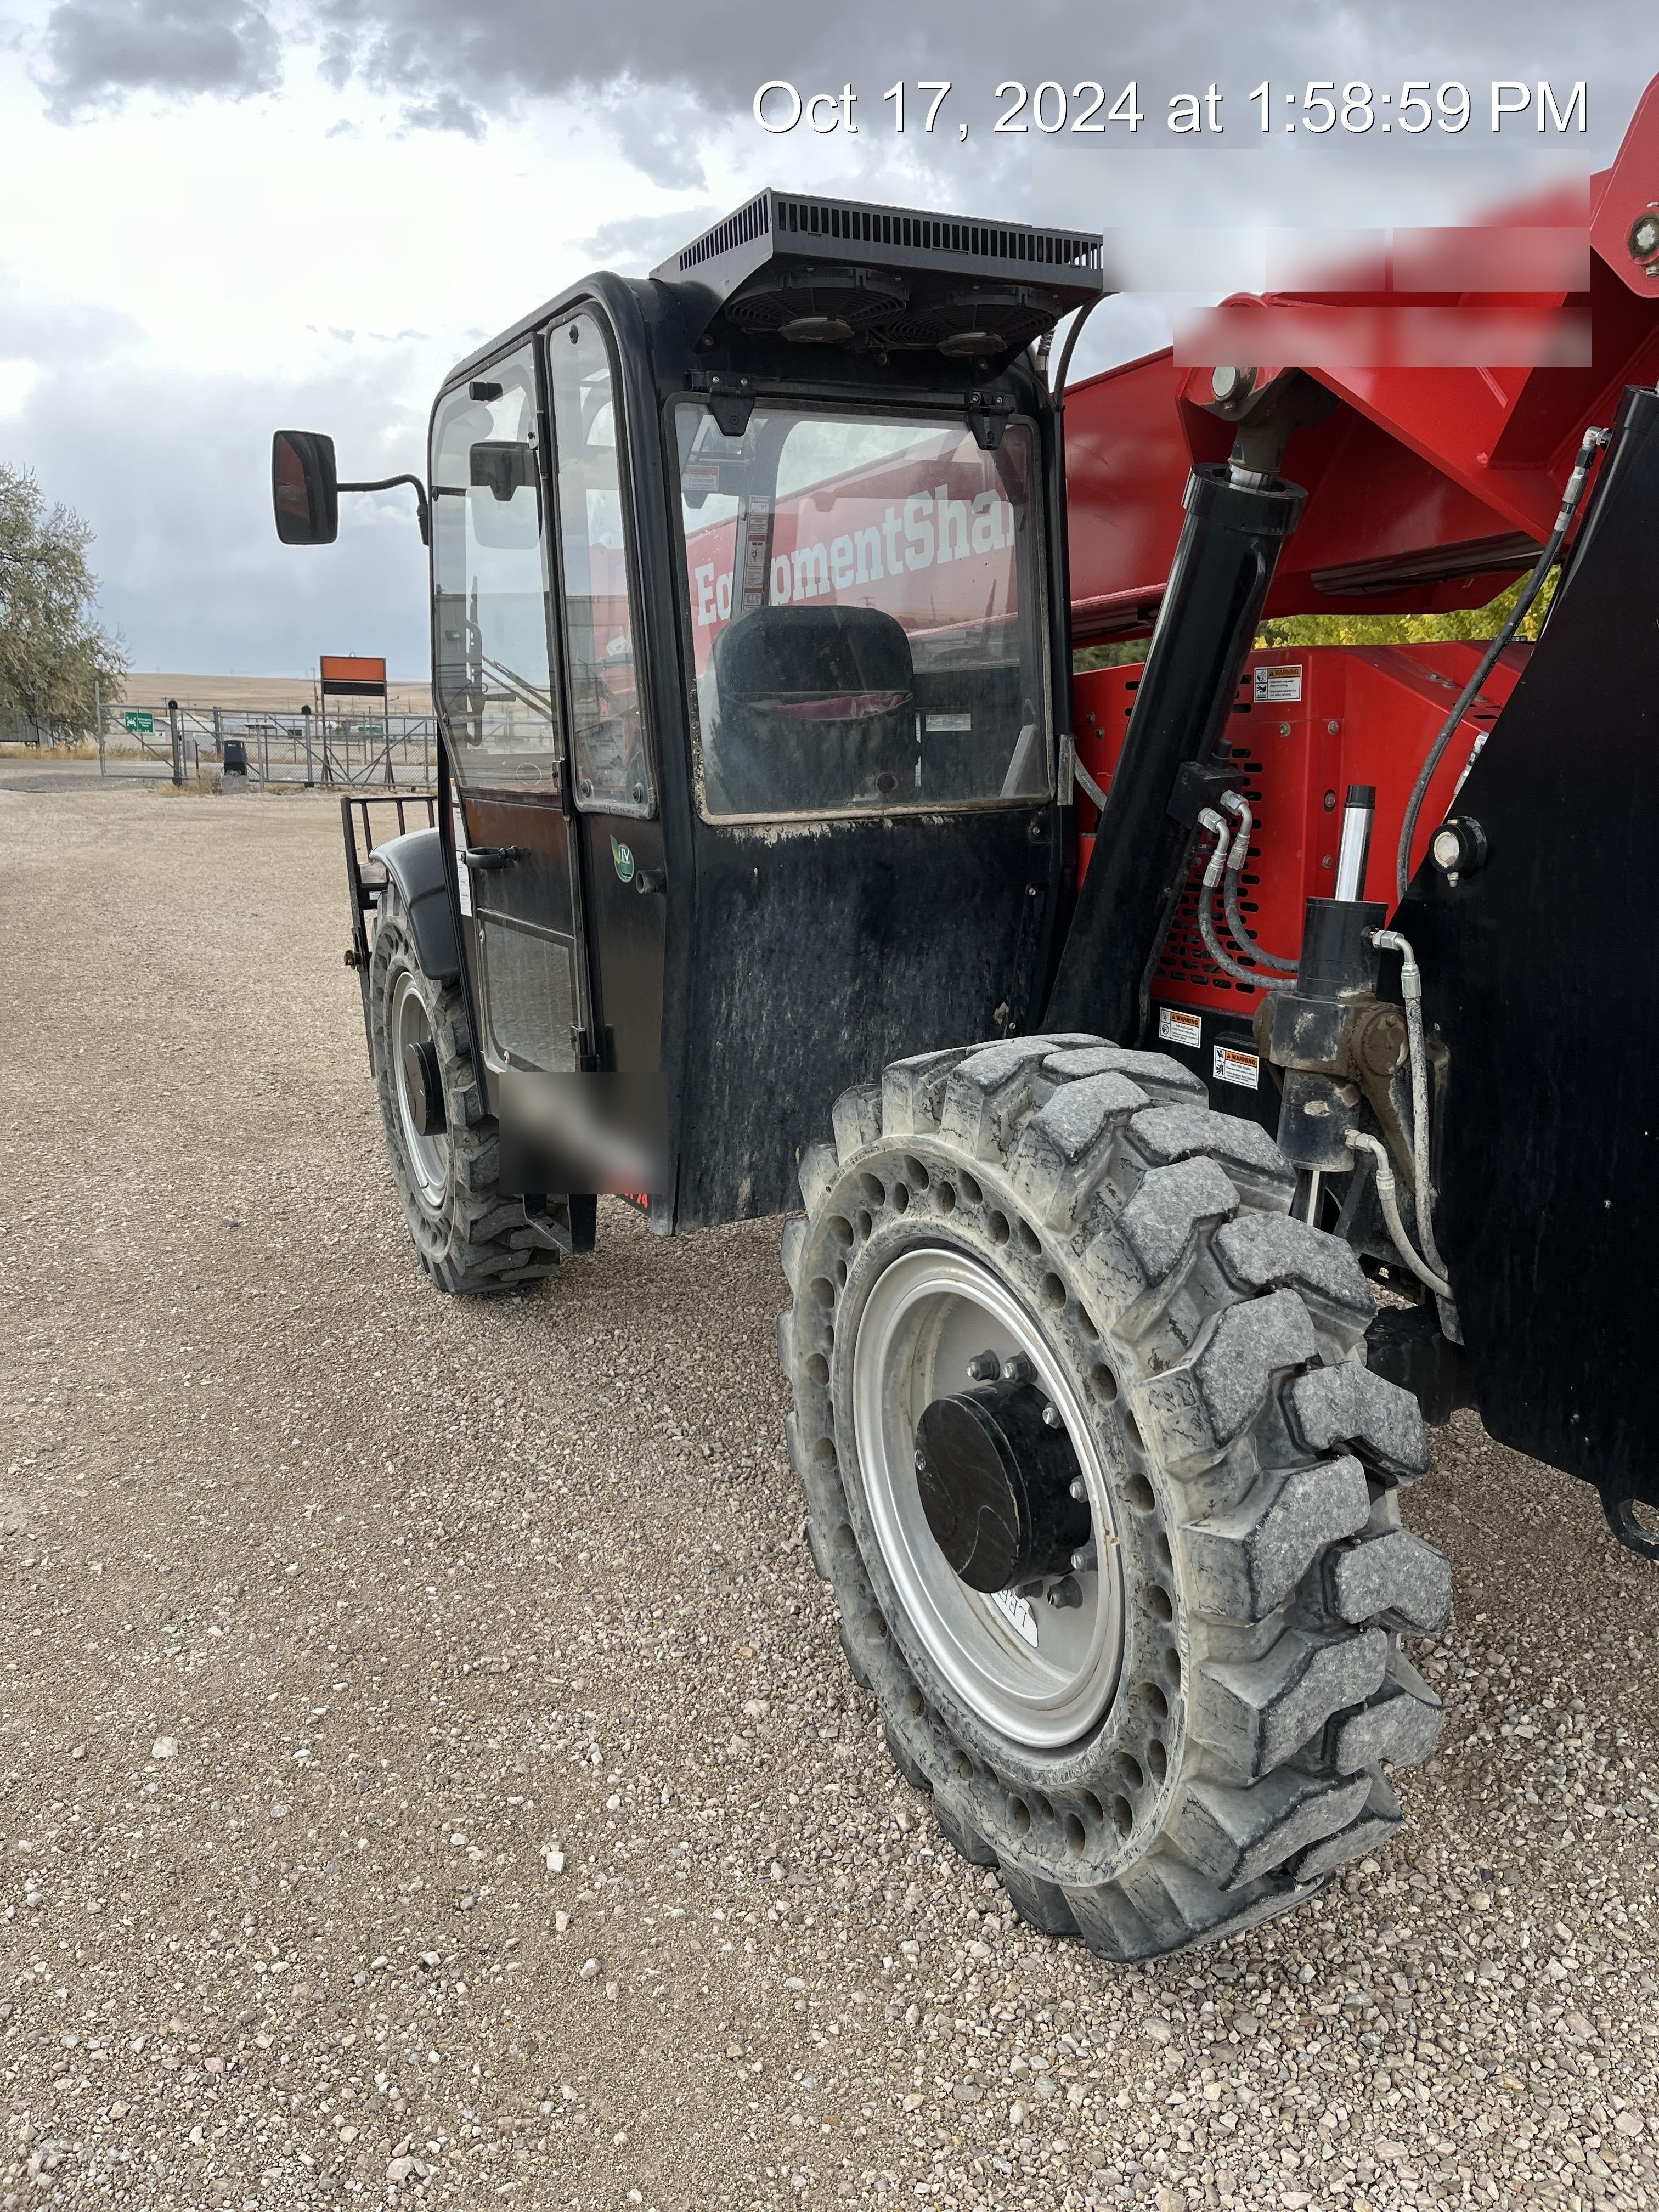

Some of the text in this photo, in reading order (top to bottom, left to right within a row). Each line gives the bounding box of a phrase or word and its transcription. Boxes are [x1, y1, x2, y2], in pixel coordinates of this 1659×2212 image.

[1176, 1014, 1198, 1025] WARNING
[1231, 1054, 1256, 1065] WARNING
[997, 1589, 1028, 1629] LEF
